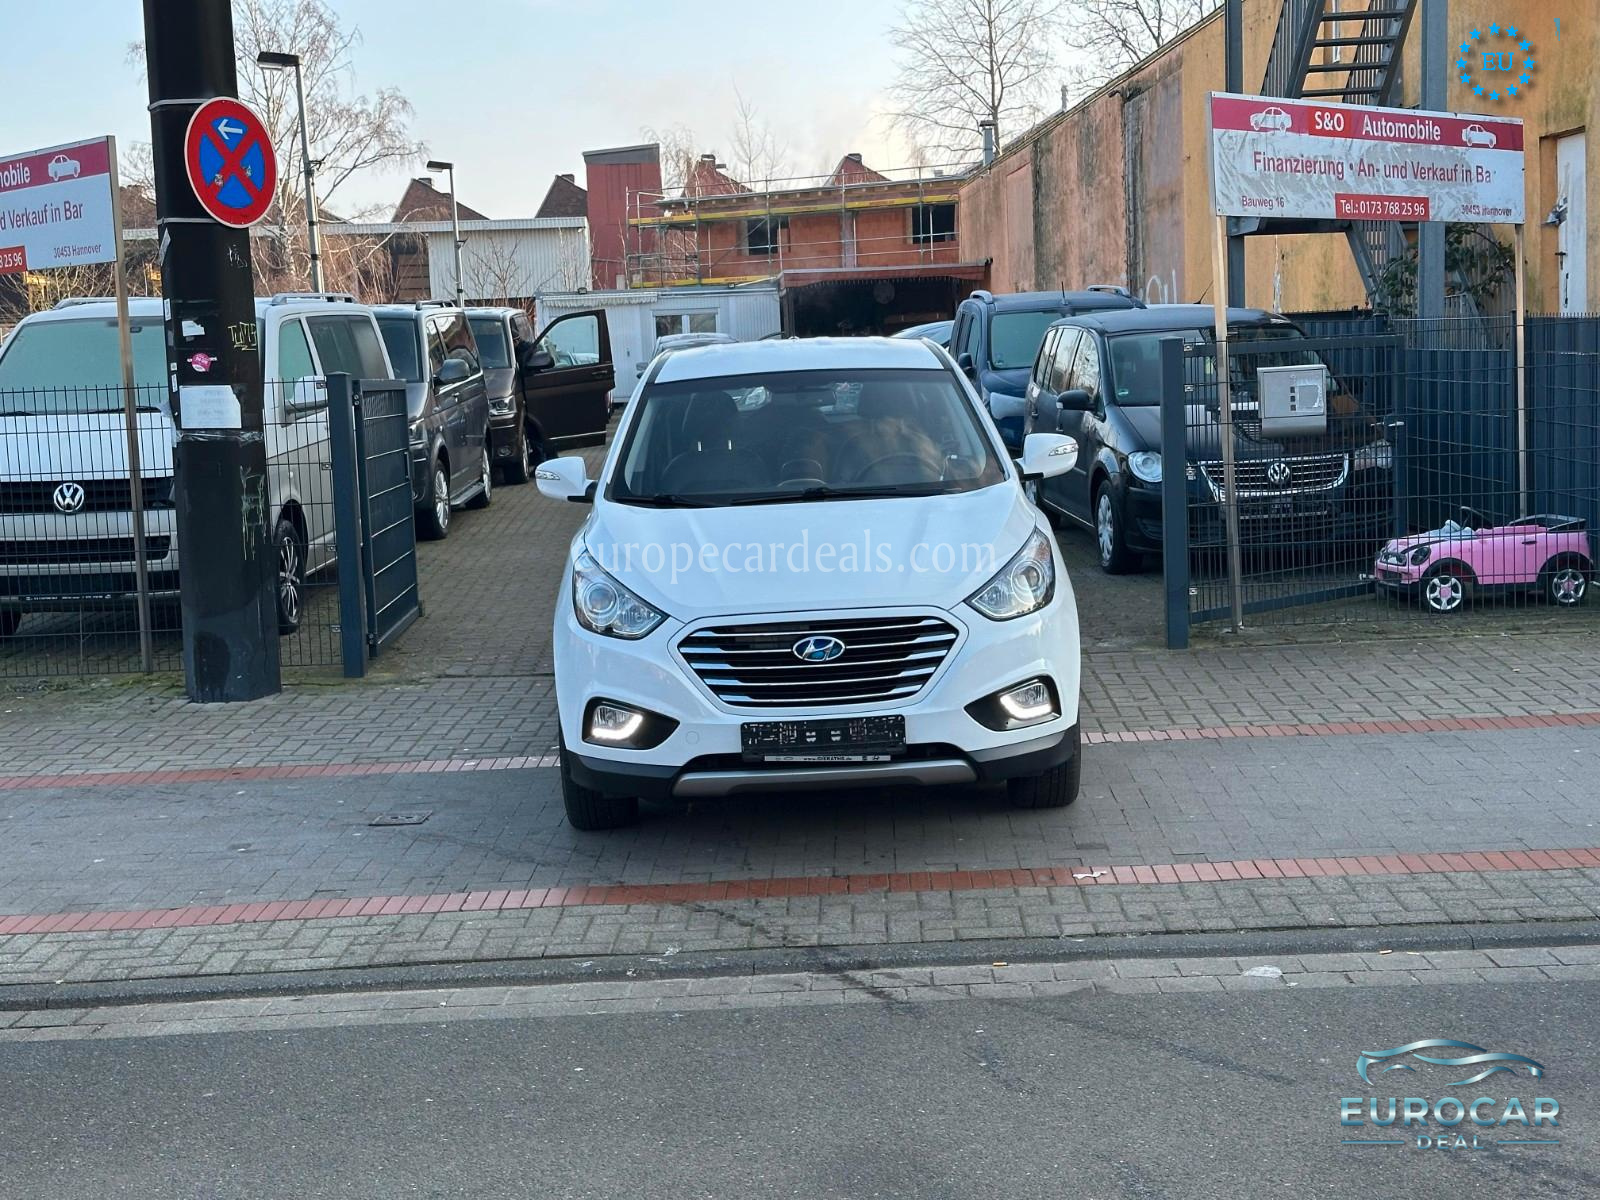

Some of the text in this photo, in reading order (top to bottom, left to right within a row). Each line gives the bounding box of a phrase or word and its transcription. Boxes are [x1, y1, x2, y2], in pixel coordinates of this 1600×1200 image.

[1314, 110, 1442, 142] S&O Automobile
[0, 162, 31, 188] obile
[1253, 151, 1497, 184] Finanzierung An- und Verkauf in Ba
[1241, 195, 1285, 210] Bauweg 16
[1360, 201, 1382, 215] 0173
[1383, 201, 1400, 216] 768
[1401, 202, 1413, 216] 25
[1413, 203, 1425, 216] 96
[8, 203, 48, 229] Verkauf
[51, 202, 62, 222] in
[63, 200, 84, 221] Bar
[4, 253, 13, 268] 25
[13, 251, 23, 267] 96
[53, 243, 102, 259] 30453 Hannover
